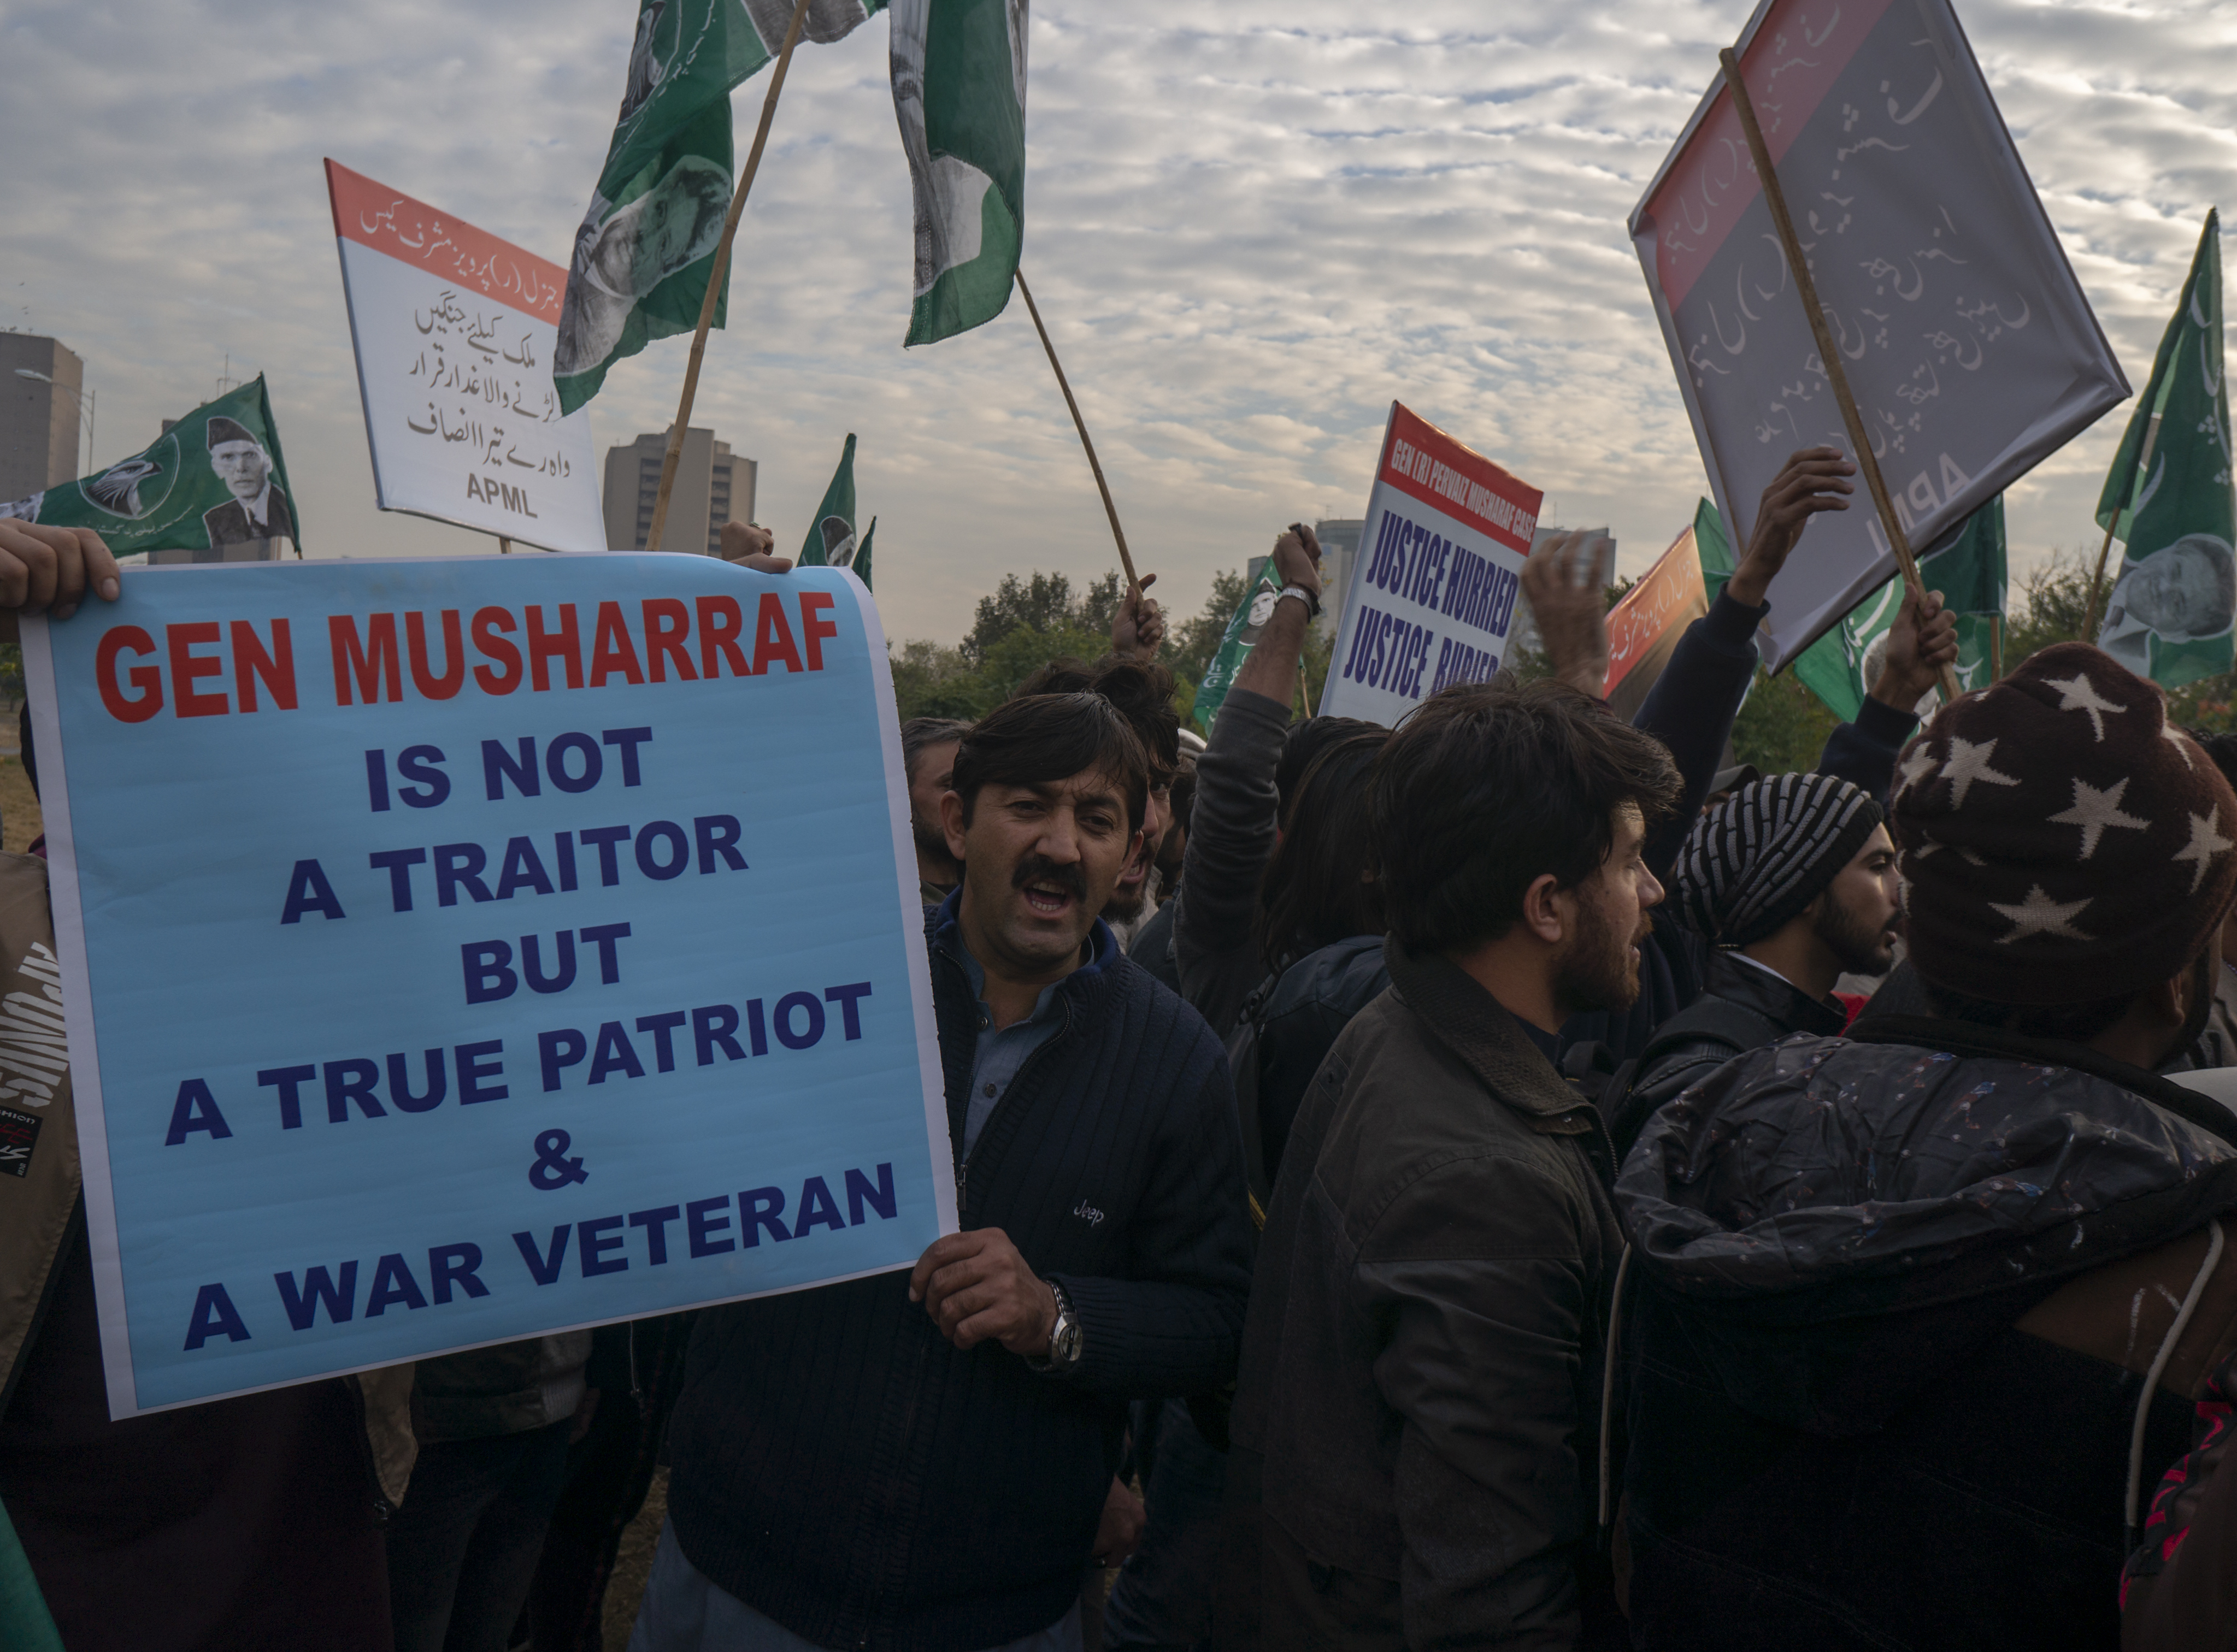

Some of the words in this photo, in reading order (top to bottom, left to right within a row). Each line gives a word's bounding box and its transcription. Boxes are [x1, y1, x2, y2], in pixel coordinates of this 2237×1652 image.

[361, 200, 404, 234] کیس
[399, 221, 451, 258] مشرف
[453, 246, 490, 291] پرویز
[524, 269, 559, 310] جنرل
[409, 343, 444, 388] قرار
[444, 364, 480, 394] غدار
[503, 333, 535, 368] ملک
[467, 473, 538, 518] APML
[1391, 438, 1416, 477] GEN
[1428, 459, 1470, 506] PERVAIZ
[1466, 481, 1516, 532] MUSHARAF
[1511, 508, 1536, 543] CASE
[1366, 509, 1452, 610] JUSTICE
[1440, 545, 1518, 638] HURRIED
[96, 618, 299, 723] GEN
[328, 592, 838, 706] MUSHARRAF
[1343, 604, 1434, 699] JUSTICE
[365, 744, 451, 812] IS
[481, 727, 653, 801] NOT
[280, 859, 346, 924] A
[369, 814, 749, 913] TRAITOR
[462, 922, 632, 1005] BUT
[164, 1078, 233, 1146] A
[257, 1039, 509, 1130] TRUE
[538, 981, 872, 1092] PATRIOT
[528, 1129, 590, 1190] &
[1074, 1199, 1104, 1227] Jeep
[184, 1282, 251, 1351] A
[274, 1242, 491, 1331] WAR
[511, 1162, 898, 1286] VETERAN
